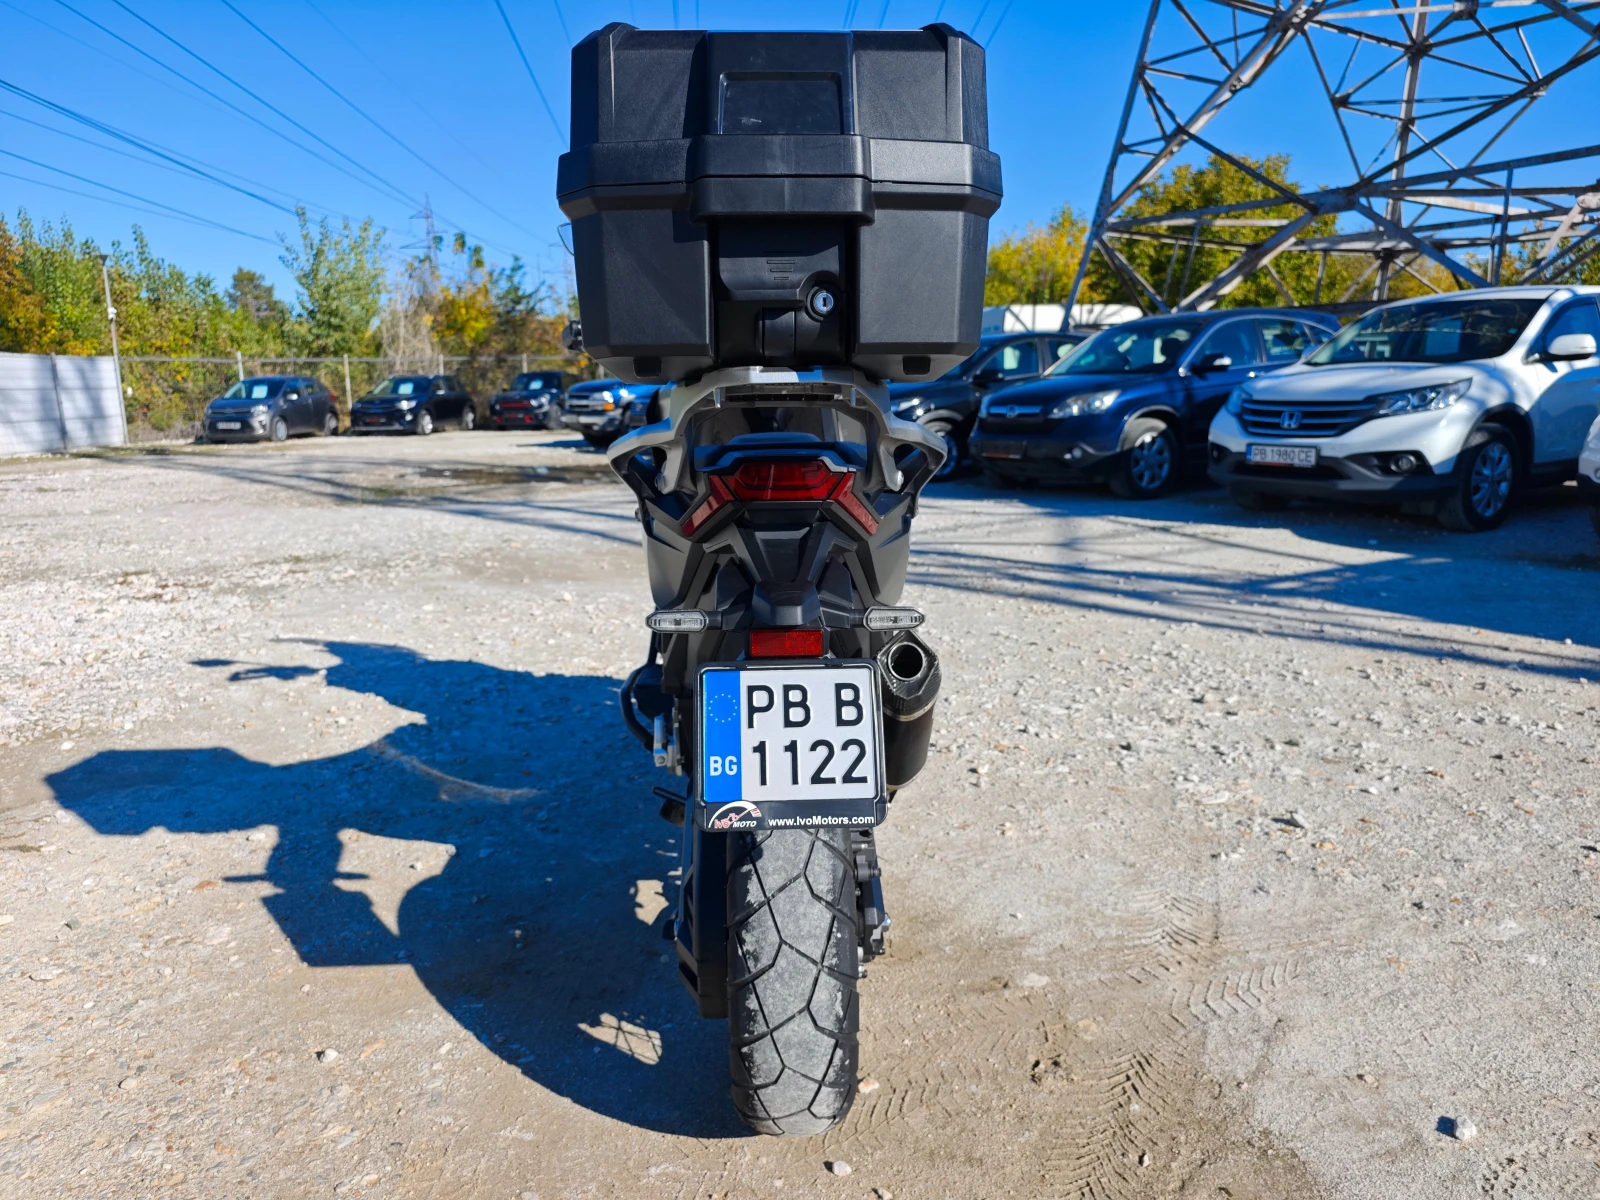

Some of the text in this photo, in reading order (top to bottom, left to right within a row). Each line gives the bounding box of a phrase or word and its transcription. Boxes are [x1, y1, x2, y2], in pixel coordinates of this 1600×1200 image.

[746, 682, 865, 729] PB B
[709, 755, 738, 776] BG
[752, 738, 869, 786] 1122
[732, 820, 757, 828] MOTO
[768, 815, 875, 827] www.IvoMotors.com
